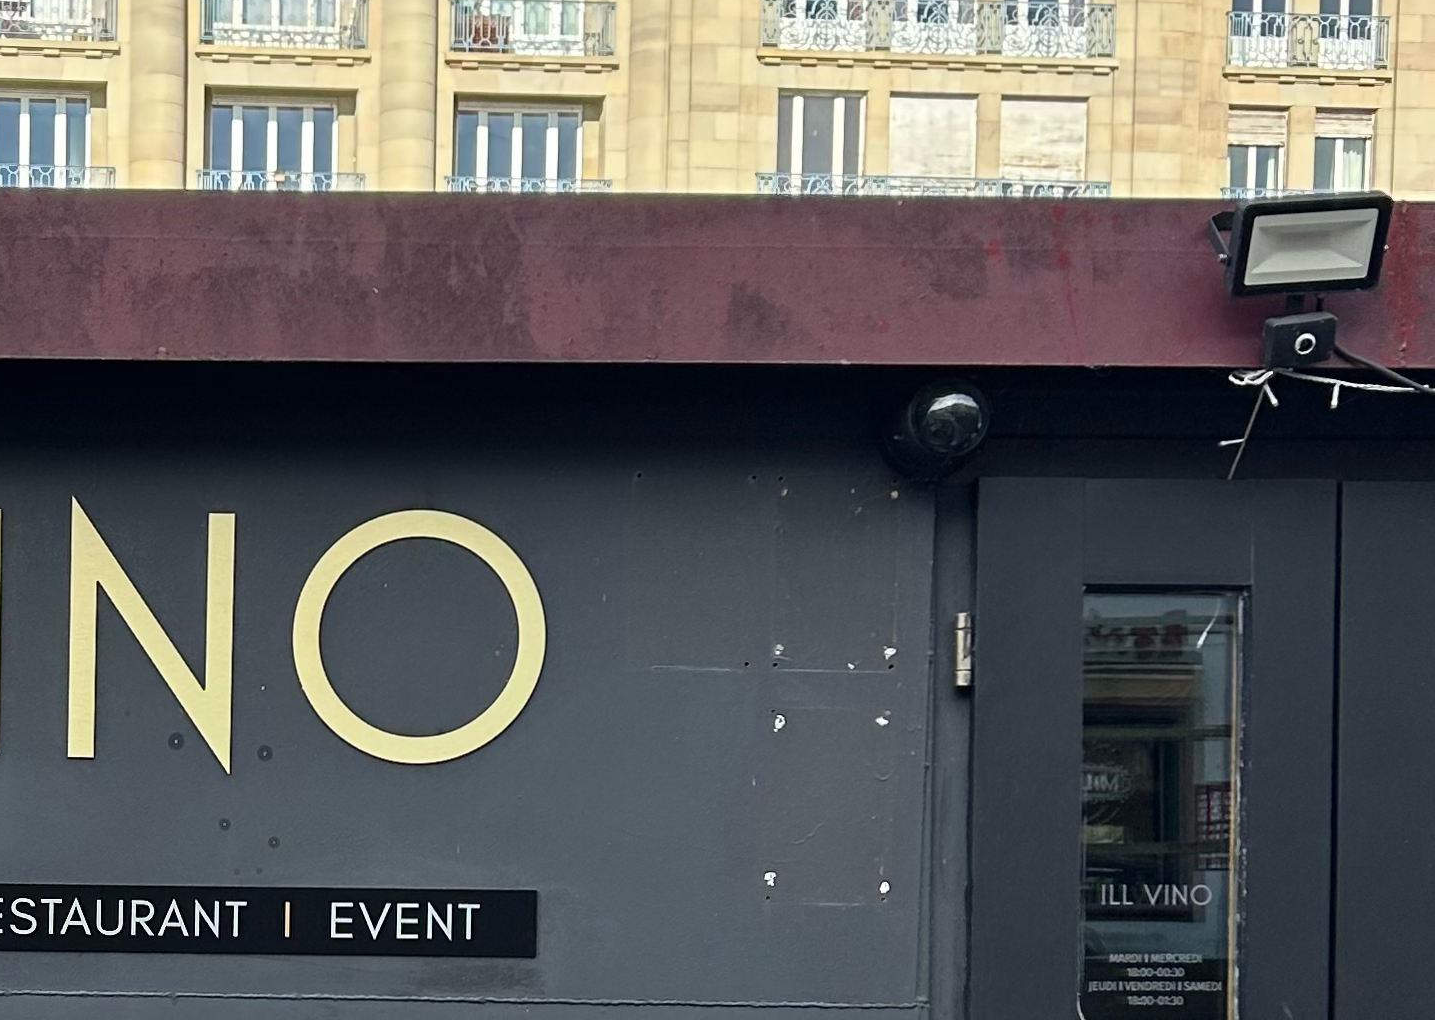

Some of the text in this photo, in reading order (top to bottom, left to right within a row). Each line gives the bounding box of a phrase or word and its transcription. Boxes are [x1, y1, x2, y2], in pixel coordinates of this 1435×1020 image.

[1101, 884, 1213, 906] ILL VINO
[329, 901, 482, 941] EVENT
[1109, 953, 1203, 963] MARDI MERCREDI
[1088, 981, 1223, 992] JEUDI VENDREDI SAMEDI
